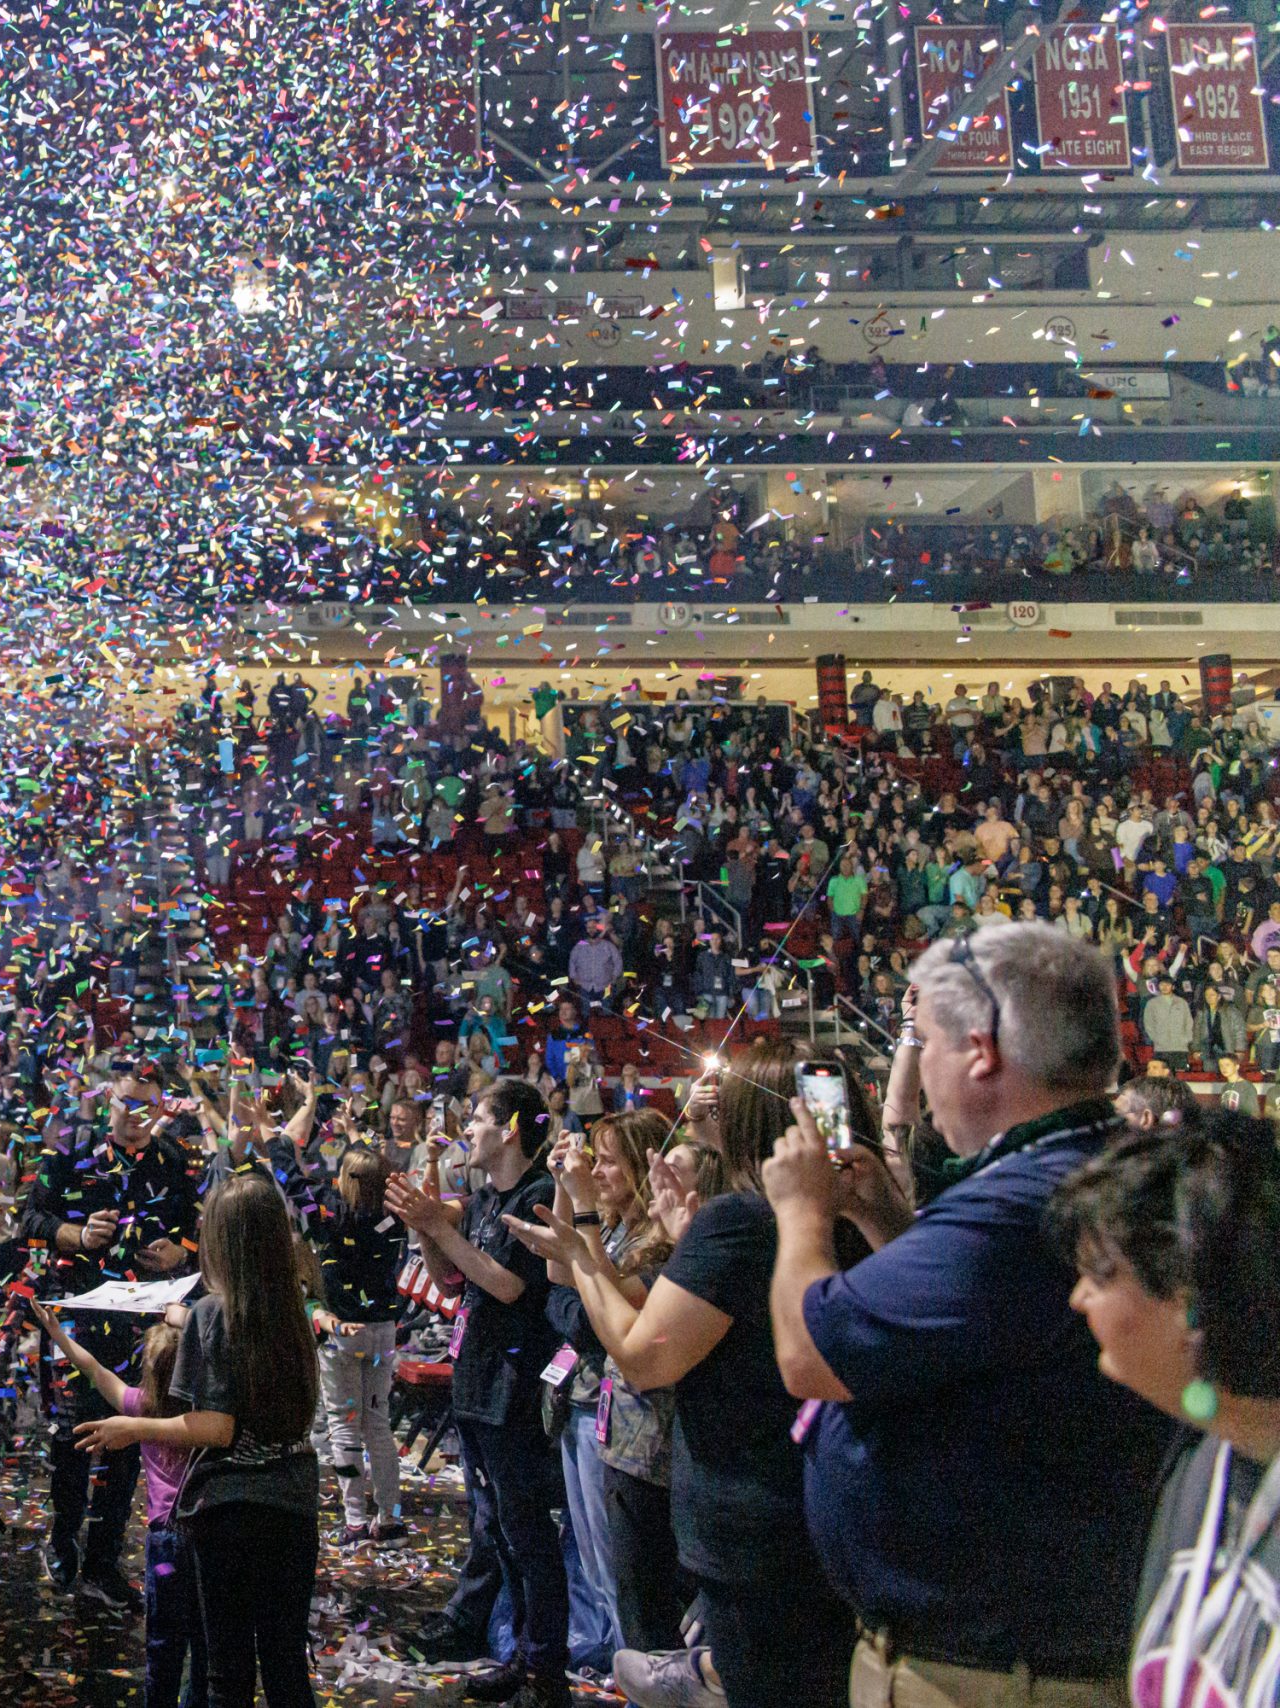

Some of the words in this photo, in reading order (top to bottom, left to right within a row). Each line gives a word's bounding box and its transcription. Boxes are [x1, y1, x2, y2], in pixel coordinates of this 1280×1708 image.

[667, 47, 801, 84] CHAMPIONS
[929, 38, 990, 73] NCA
[1045, 38, 1110, 72] NCAA
[1058, 86, 1103, 120] 1951
[1195, 84, 1241, 119] 1952
[700, 102, 777, 150] 1983
[1190, 132, 1218, 141] HIRD
[1221, 132, 1252, 142] PLACE
[969, 131, 1000, 146] FOUR
[1085, 140, 1121, 155] EIGHT
[1189, 145, 1214, 155] EAST
[1217, 145, 1254, 155] REGION
[665, 606, 686, 620] 19
[1013, 605, 1036, 619] 120
